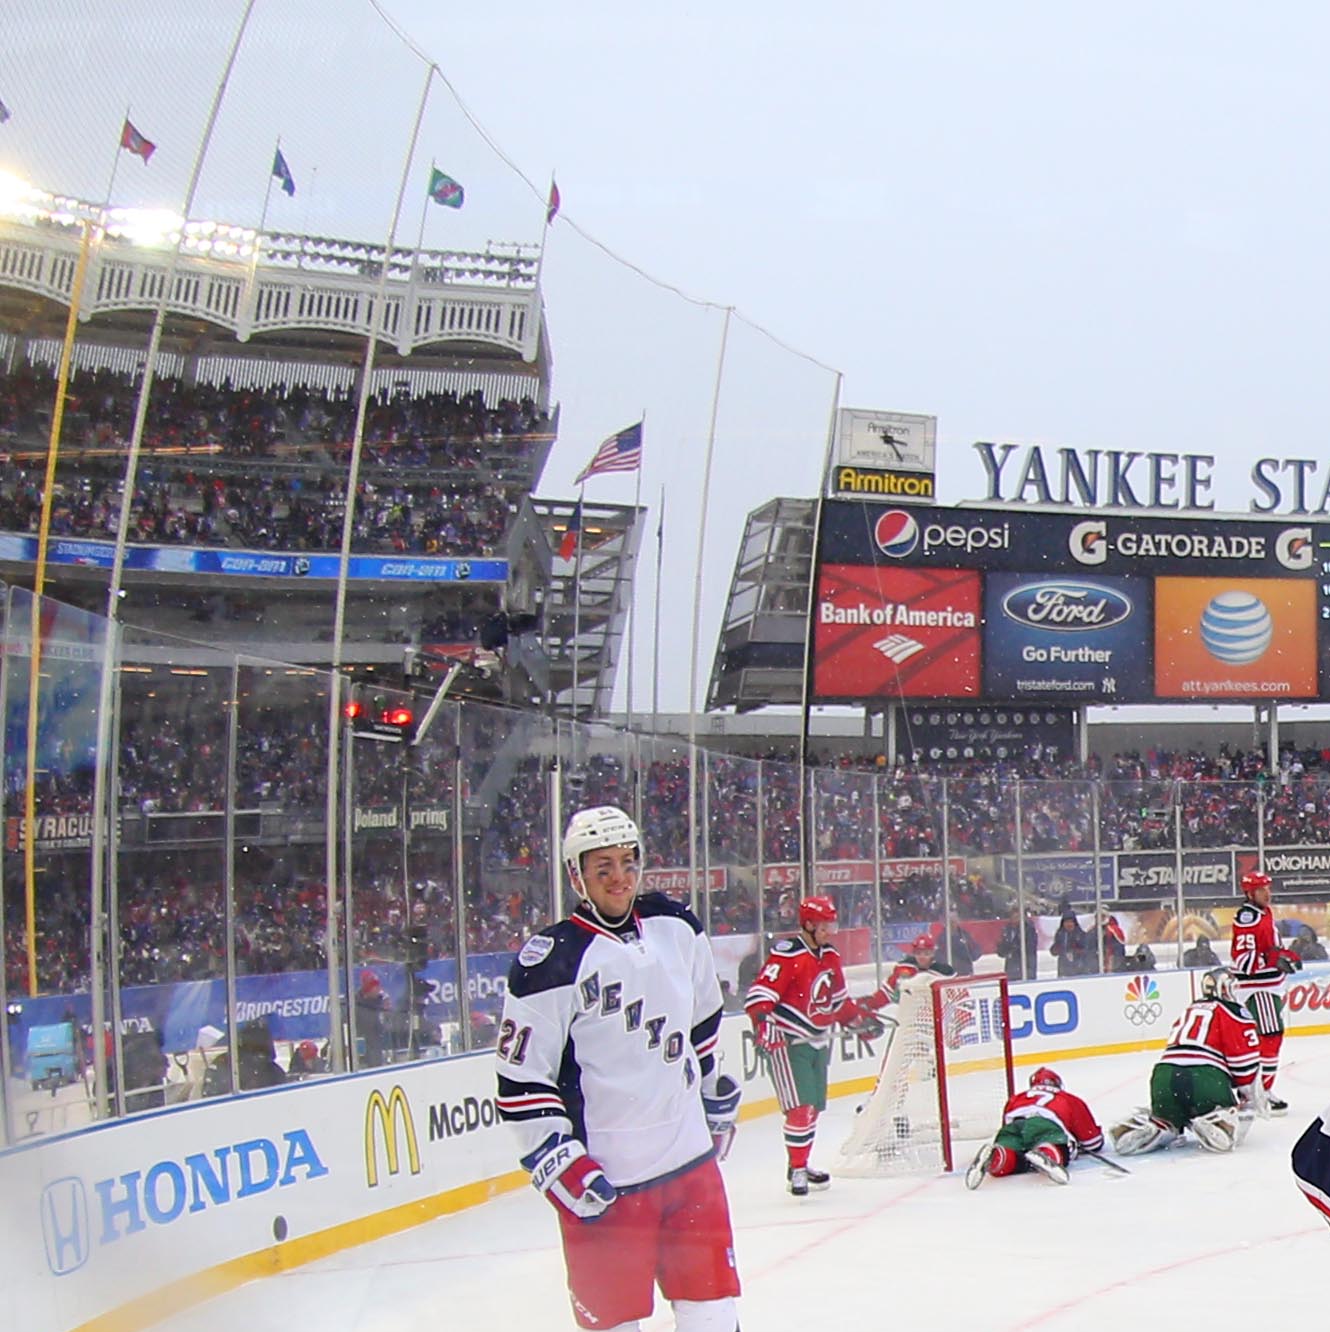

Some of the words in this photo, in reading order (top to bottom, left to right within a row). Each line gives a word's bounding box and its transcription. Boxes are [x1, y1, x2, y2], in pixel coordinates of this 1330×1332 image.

[839, 468, 933, 497] Armitron
[972, 441, 1215, 511] YANKEE
[923, 522, 1010, 553] pepsi
[1117, 532, 1266, 559] GATORADE
[820, 602, 871, 624] Bank
[872, 603, 894, 625] of
[895, 605, 975, 628] America
[1027, 587, 1106, 625] Ford
[1023, 646, 1048, 663] Go
[1050, 647, 1112, 664] Further
[1016, 678, 1095, 692] tristateford.com
[1181, 679, 1290, 697] att.yankees.com
[355, 806, 398, 832] Poland
[410, 808, 450, 831] pring
[1147, 864, 1230, 885] STARTER
[580, 971, 645, 1032] NEW
[498, 1018, 533, 1066] 21
[94, 1128, 329, 1246] HONDA
